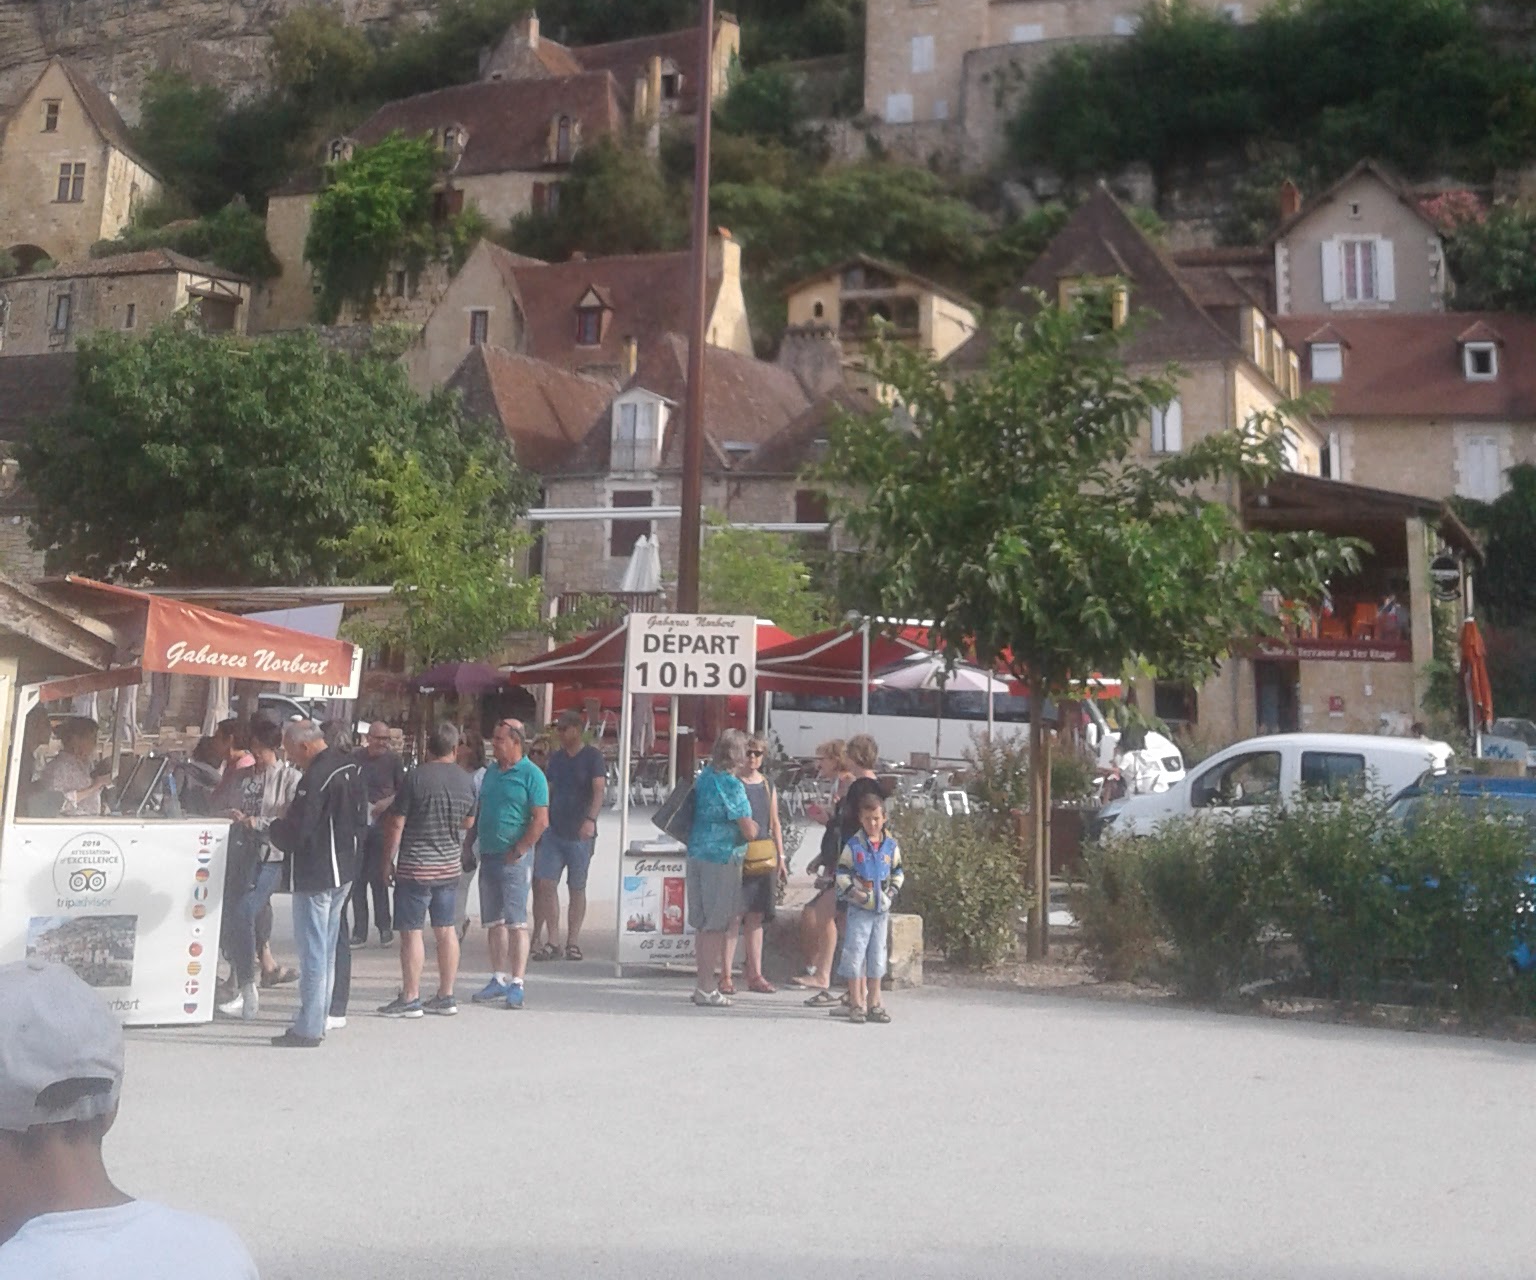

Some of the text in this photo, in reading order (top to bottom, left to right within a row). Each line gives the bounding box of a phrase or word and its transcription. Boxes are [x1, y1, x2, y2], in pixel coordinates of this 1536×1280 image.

[647, 615, 736, 629] Gabares Norbert
[643, 627, 740, 655] DÉPART
[166, 641, 247, 669] Gabares
[253, 649, 329, 675] Norbert
[635, 661, 747, 688] 10h30
[635, 859, 683, 876] Gabares
[57, 897, 112, 910] tripadvisor
